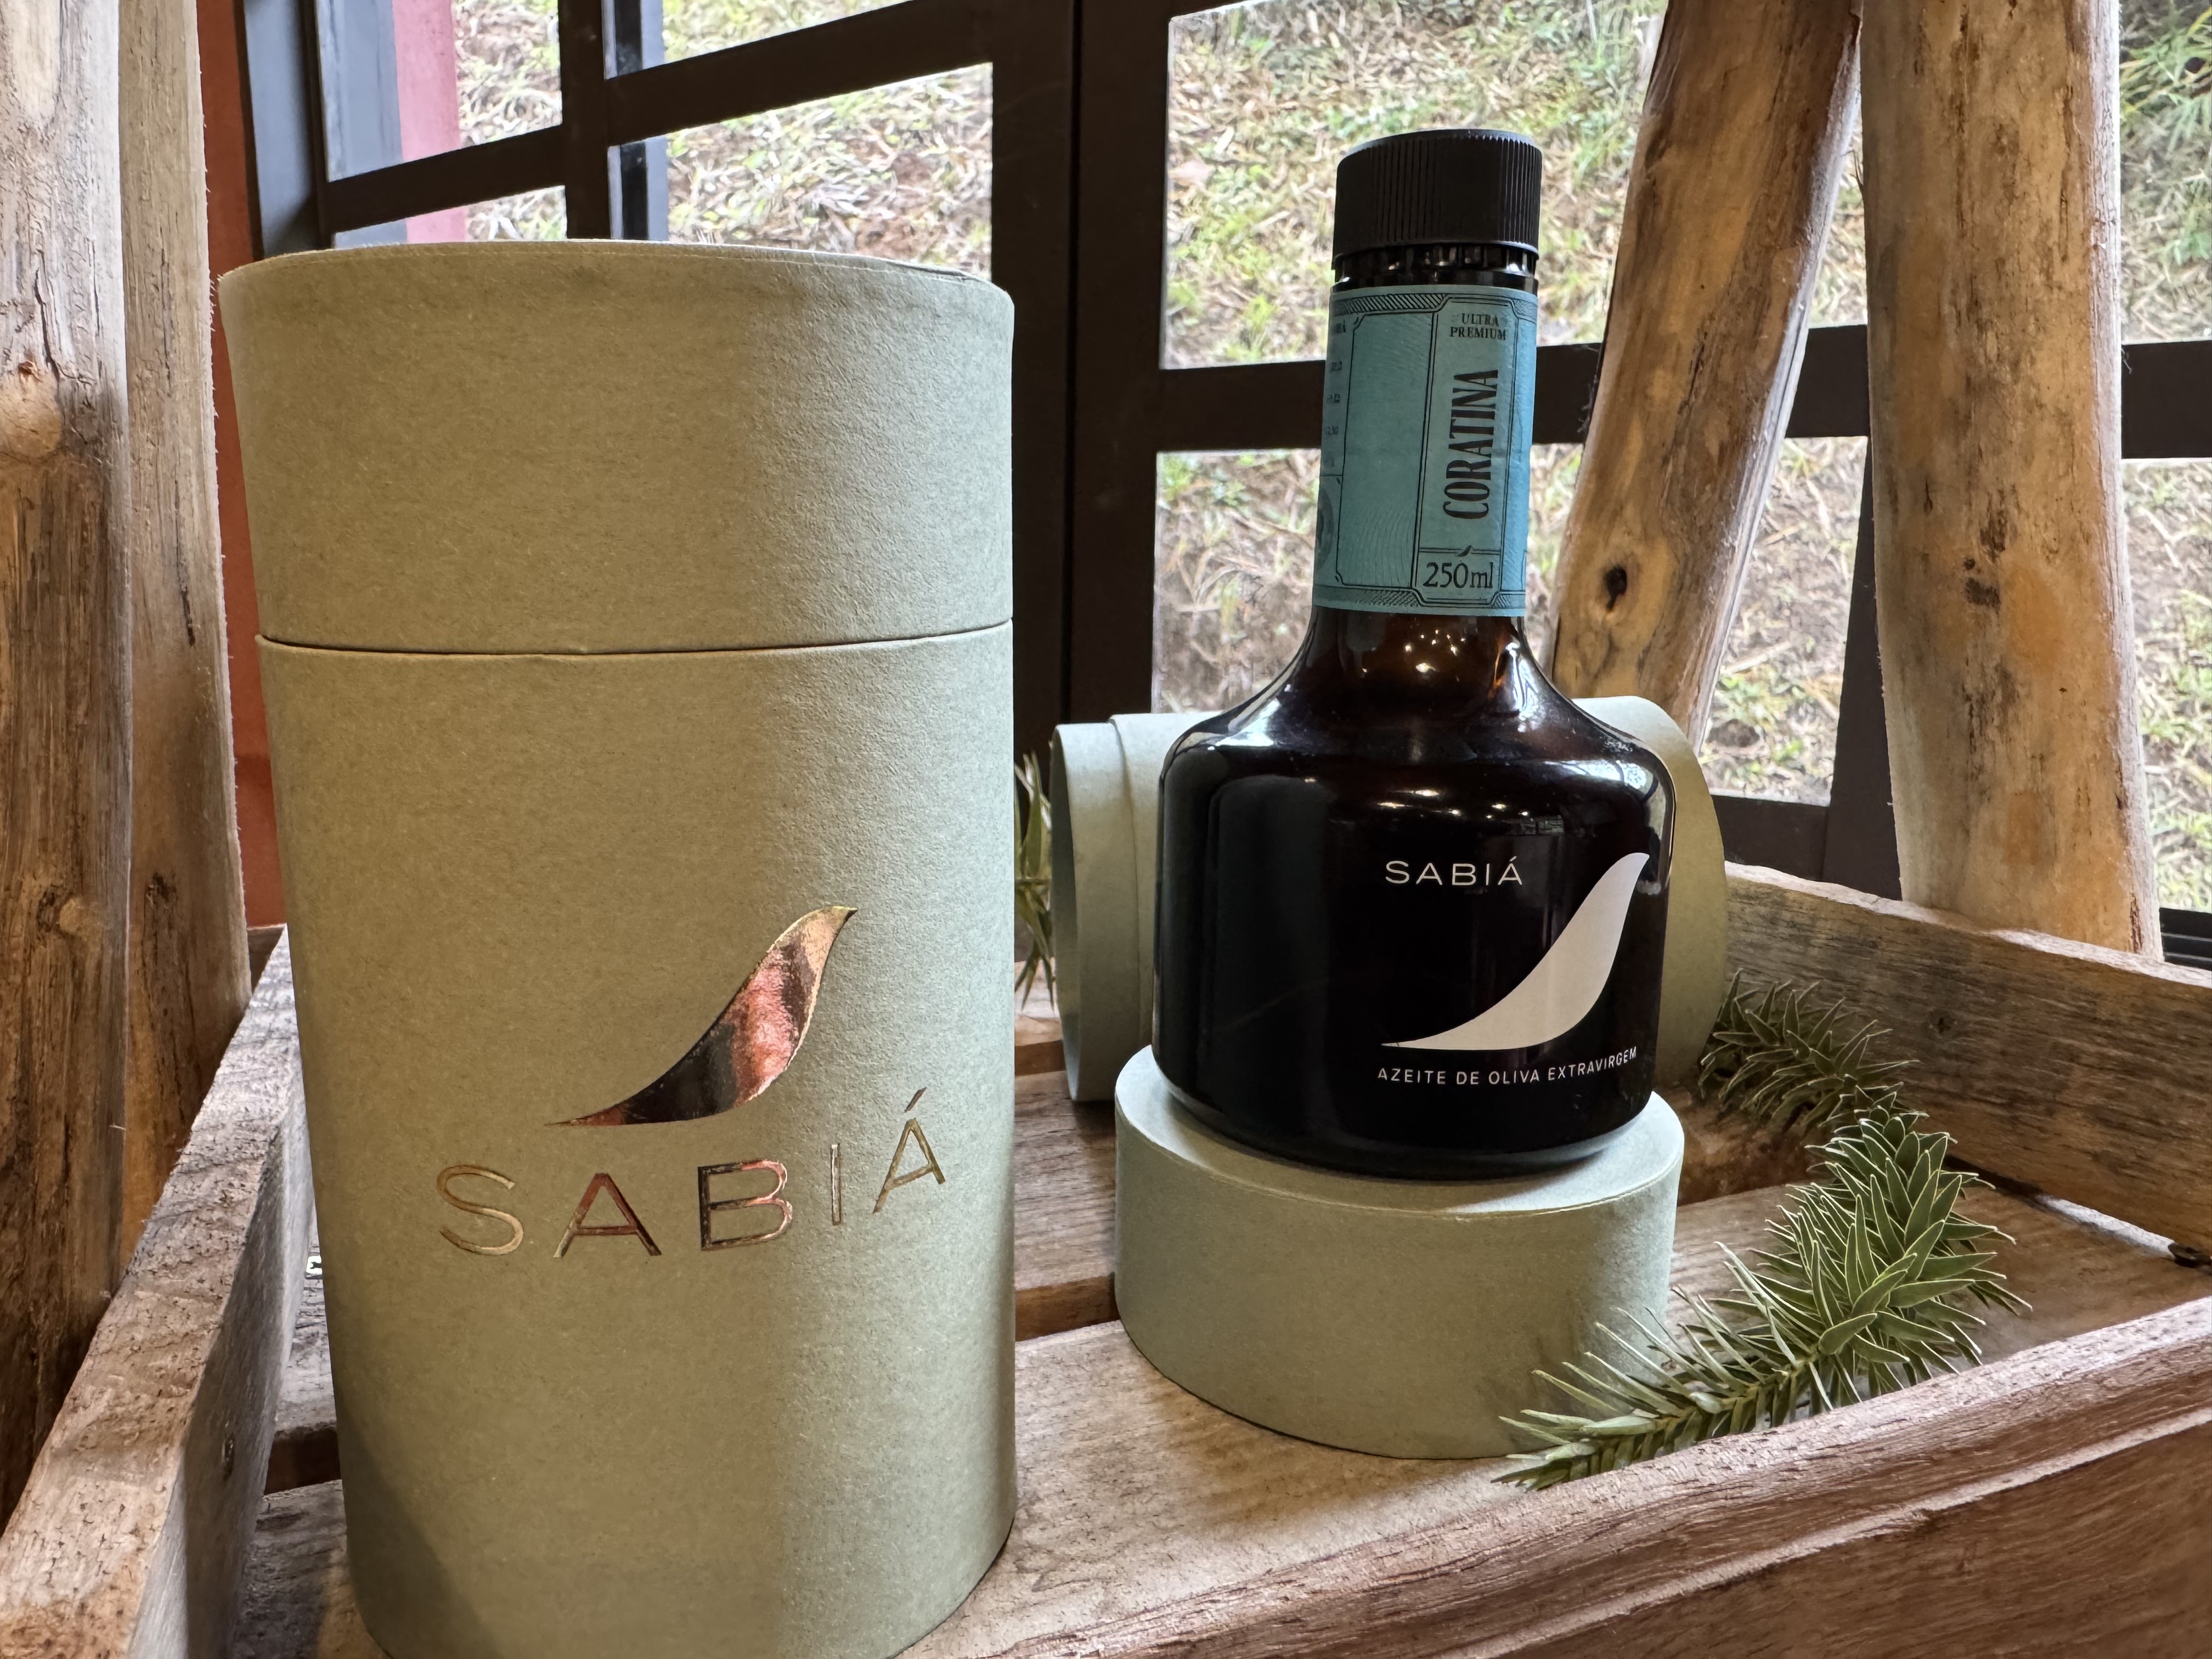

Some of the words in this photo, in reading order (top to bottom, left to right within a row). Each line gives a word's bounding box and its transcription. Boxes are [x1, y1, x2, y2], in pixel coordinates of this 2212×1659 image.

[1450, 326, 1506, 340] PREMIUM
[1462, 313, 1499, 327] ULTRA
[1443, 369, 1499, 520] CORATINA
[1423, 562, 1494, 589] 250ml
[1385, 856, 1522, 885] SABIÁ
[1378, 1068, 1446, 1085] AZEITE
[1456, 1071, 1480, 1085] DE
[1488, 1069, 1539, 1085] OLIVA
[1548, 1046, 1637, 1081] EXTRAVIRGEM
[437, 1087, 946, 1259] SABIÁ
